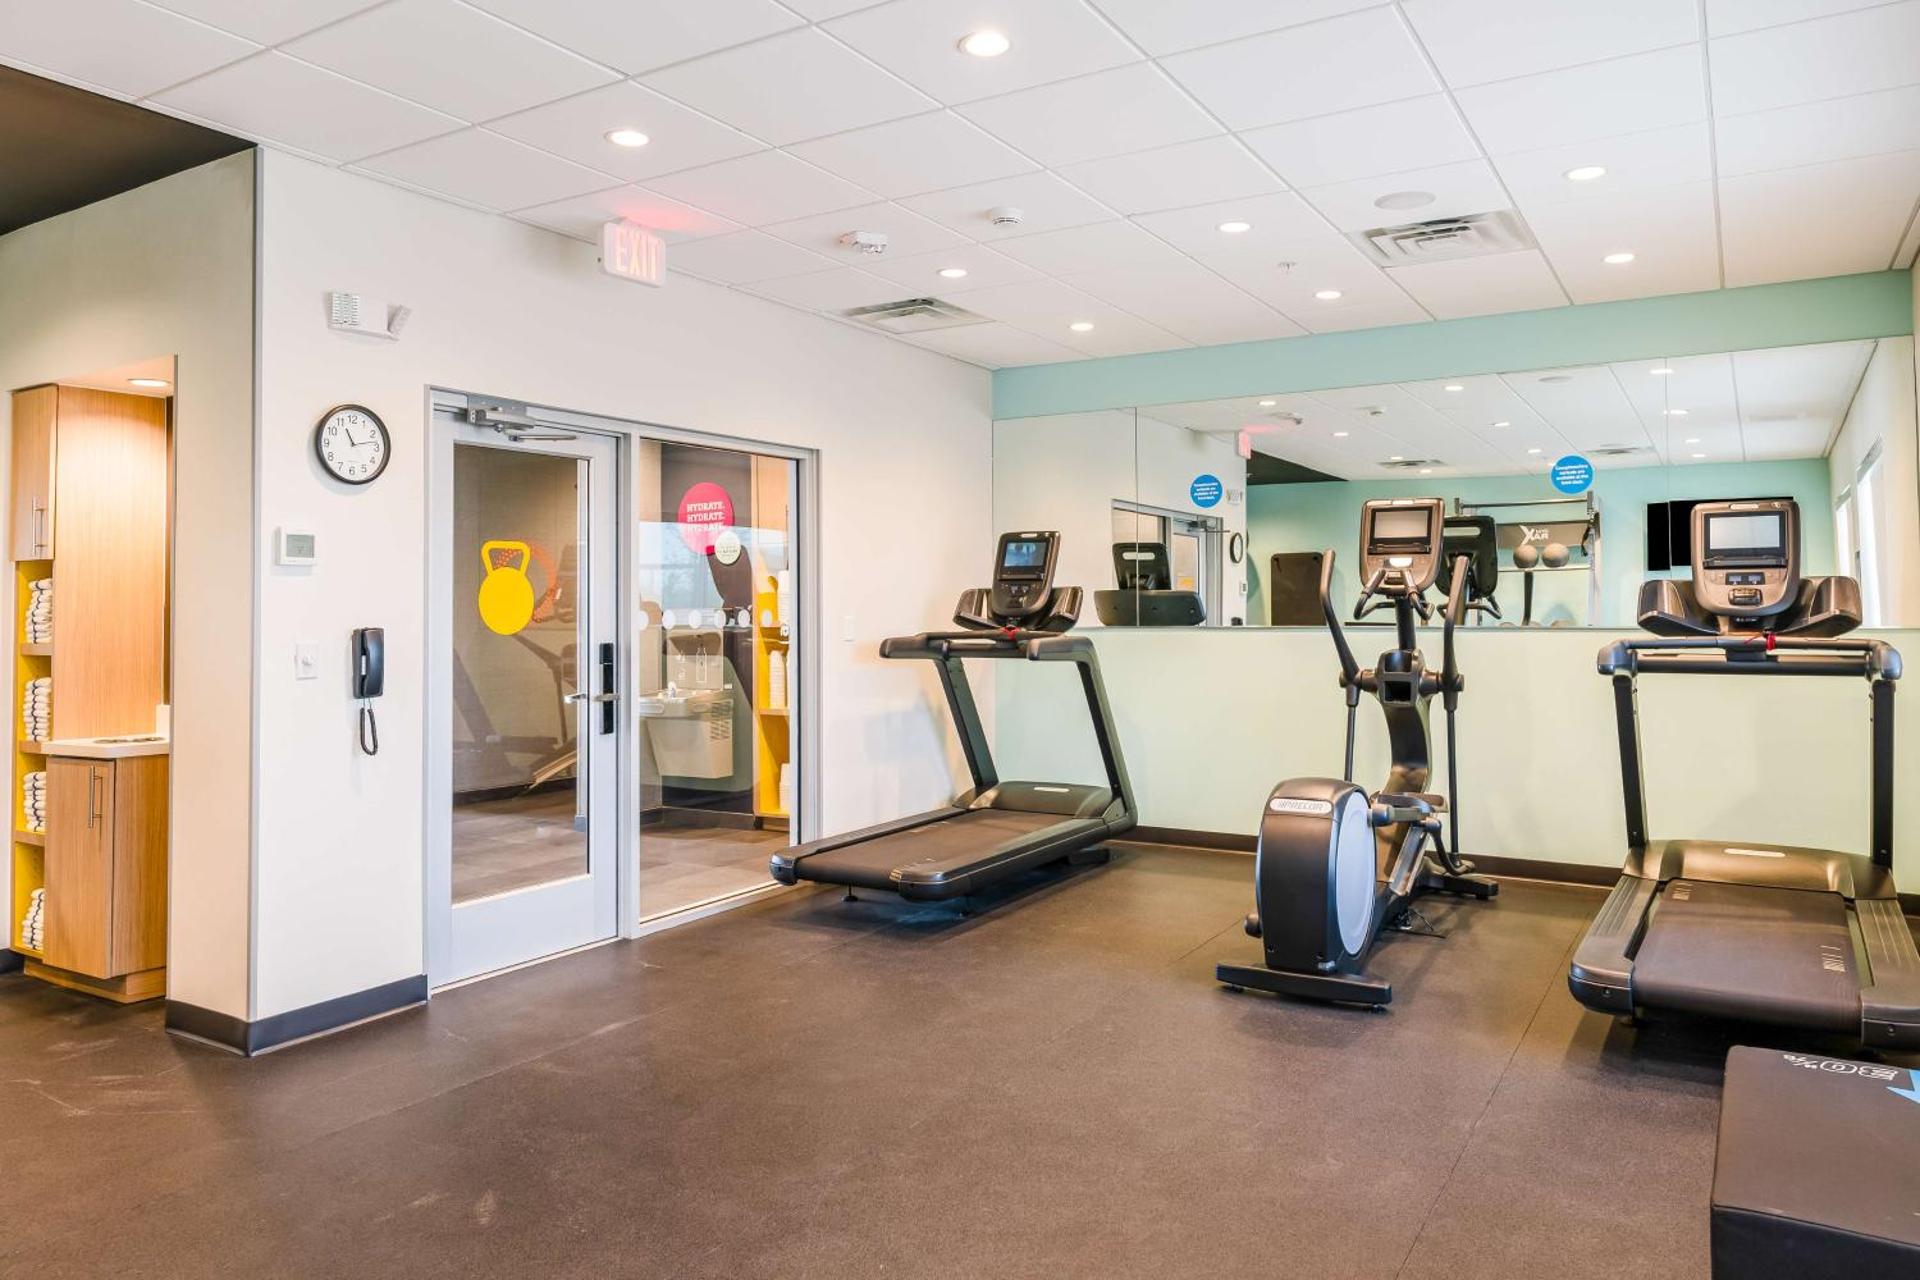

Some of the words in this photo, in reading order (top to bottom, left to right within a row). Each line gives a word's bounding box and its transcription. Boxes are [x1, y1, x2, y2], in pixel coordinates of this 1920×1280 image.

[616, 228, 660, 280] EXIT
[337, 417, 344, 427] 11
[348, 415, 358, 424] 12
[328, 426, 338, 436] 10
[370, 430, 376, 438] 2
[324, 438, 329, 447] 9
[374, 443, 380, 452] 3
[328, 452, 334, 461] 8
[349, 466, 355, 475] 6
